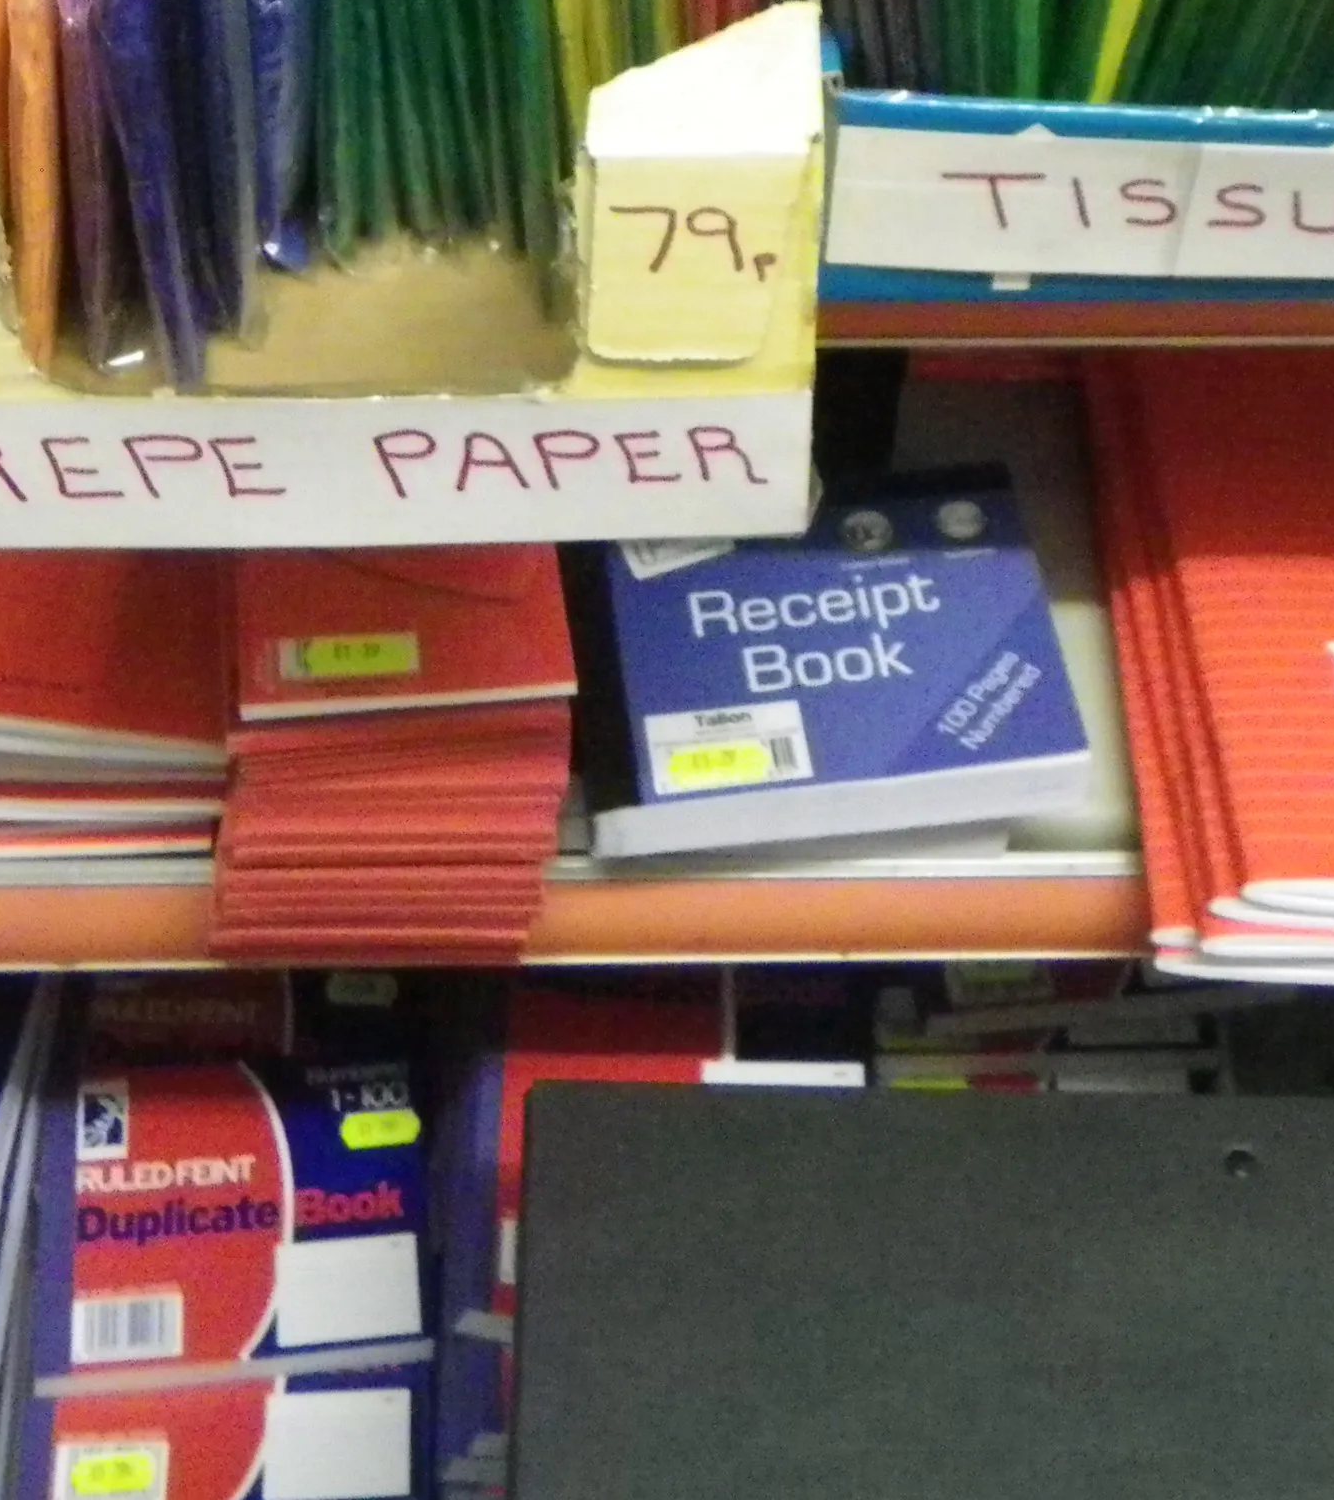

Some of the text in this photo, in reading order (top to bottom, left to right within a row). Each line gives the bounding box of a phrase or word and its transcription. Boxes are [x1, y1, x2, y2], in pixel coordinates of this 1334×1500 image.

[372, 426, 769, 500] PAPER
[686, 573, 942, 639] Receipt
[741, 632, 915, 694] Book
[936, 650, 1020, 736] 100 Pages
[959, 662, 1043, 751] Numbered
[75, 1153, 257, 1195] RULED FEINT
[77, 1180, 405, 1246] Duplicate Book
